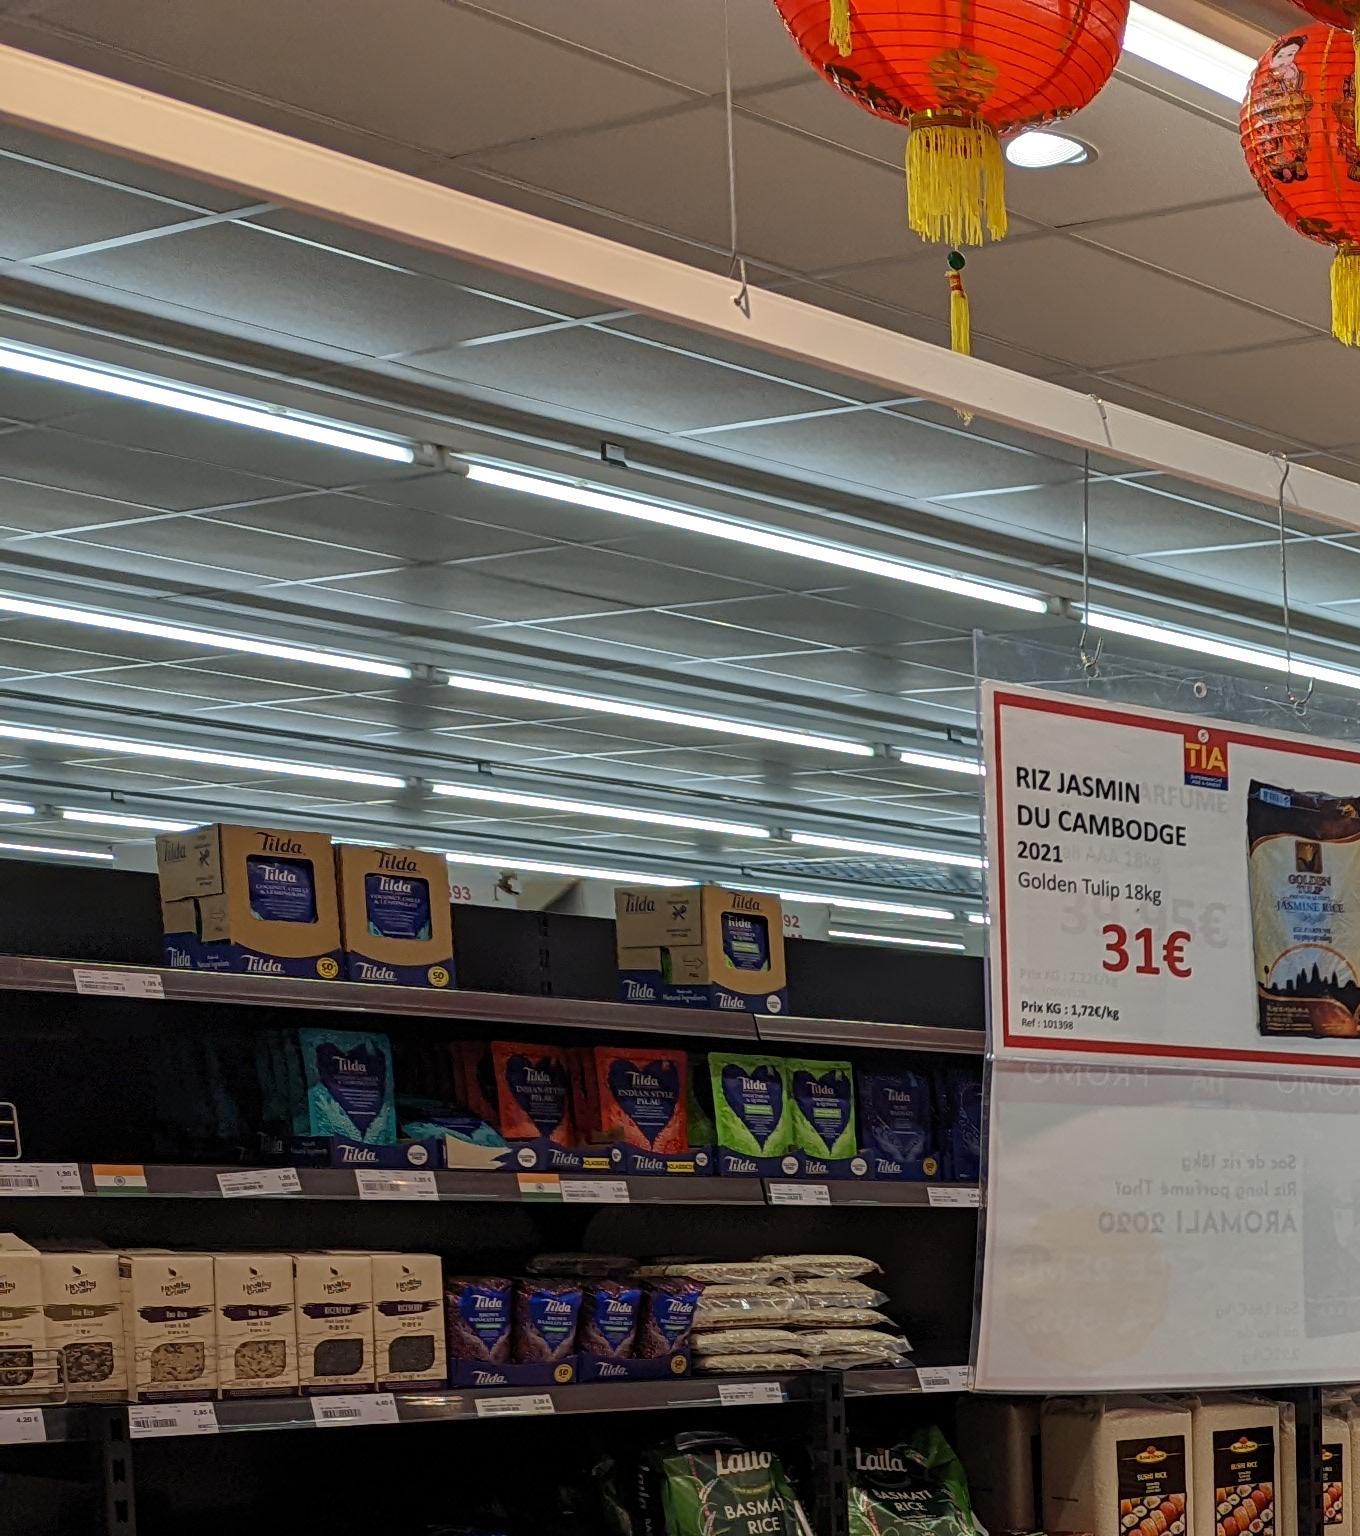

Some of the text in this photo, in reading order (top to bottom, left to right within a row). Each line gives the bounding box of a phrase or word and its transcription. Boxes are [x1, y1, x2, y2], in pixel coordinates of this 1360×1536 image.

[1185, 742, 1226, 772] TIA
[1016, 766, 1140, 804] RIZ JASMIN
[1017, 805, 1187, 846] DU CAMBODGE
[255, 831, 303, 856] Tilda
[1017, 841, 1063, 863] 2021
[1018, 872, 1161, 906] Golden Tulip 18kg
[1102, 924, 1192, 978] 31€
[1022, 1002, 1042, 1014] Prix
[1047, 1003, 1061, 1015] KG
[1071, 1004, 1119, 1020] 1,72€/kg
[1022, 1018, 1035, 1028] Ref
[856, 1447, 907, 1472] Laila
[872, 1489, 932, 1500] BASMATI
[893, 1501, 926, 1512] RICE
